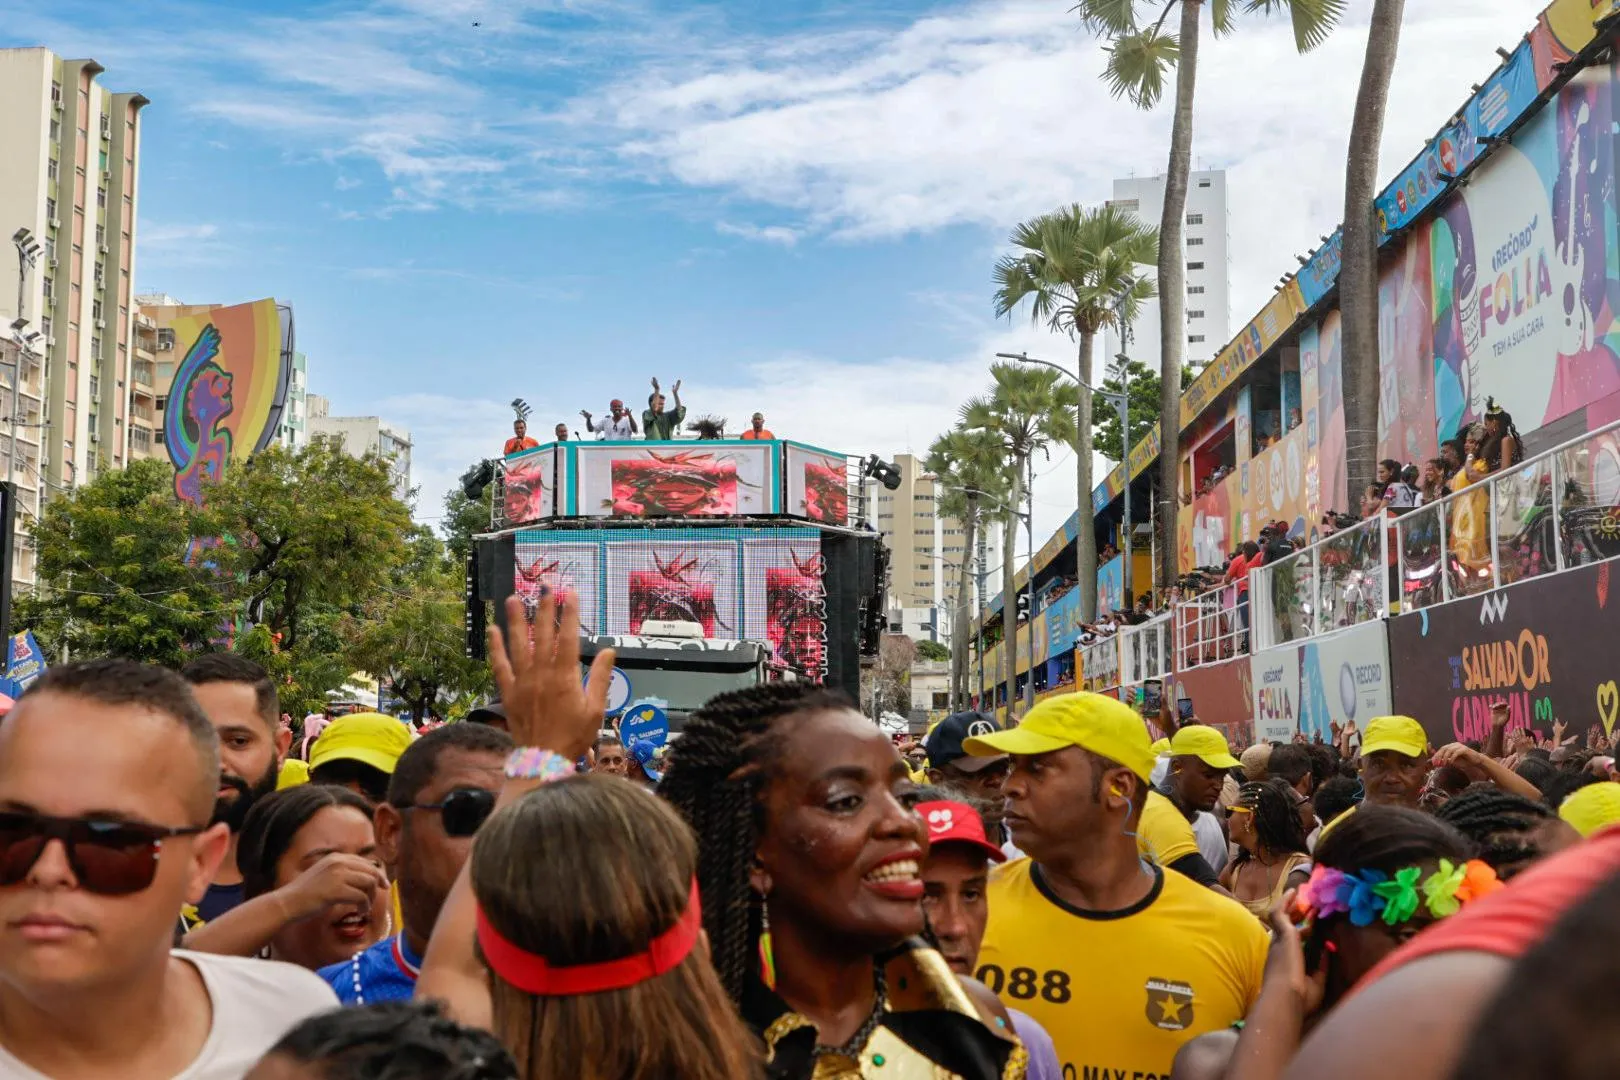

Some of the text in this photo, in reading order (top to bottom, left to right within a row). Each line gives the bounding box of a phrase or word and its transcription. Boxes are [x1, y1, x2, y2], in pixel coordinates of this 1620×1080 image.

[1494, 223, 1533, 270] RECORD
[1479, 248, 1552, 338] FOLIA
[1356, 664, 1381, 685] RECORD
[1462, 628, 1551, 691] SALVADOR
[1259, 687, 1293, 721] FOLIA
